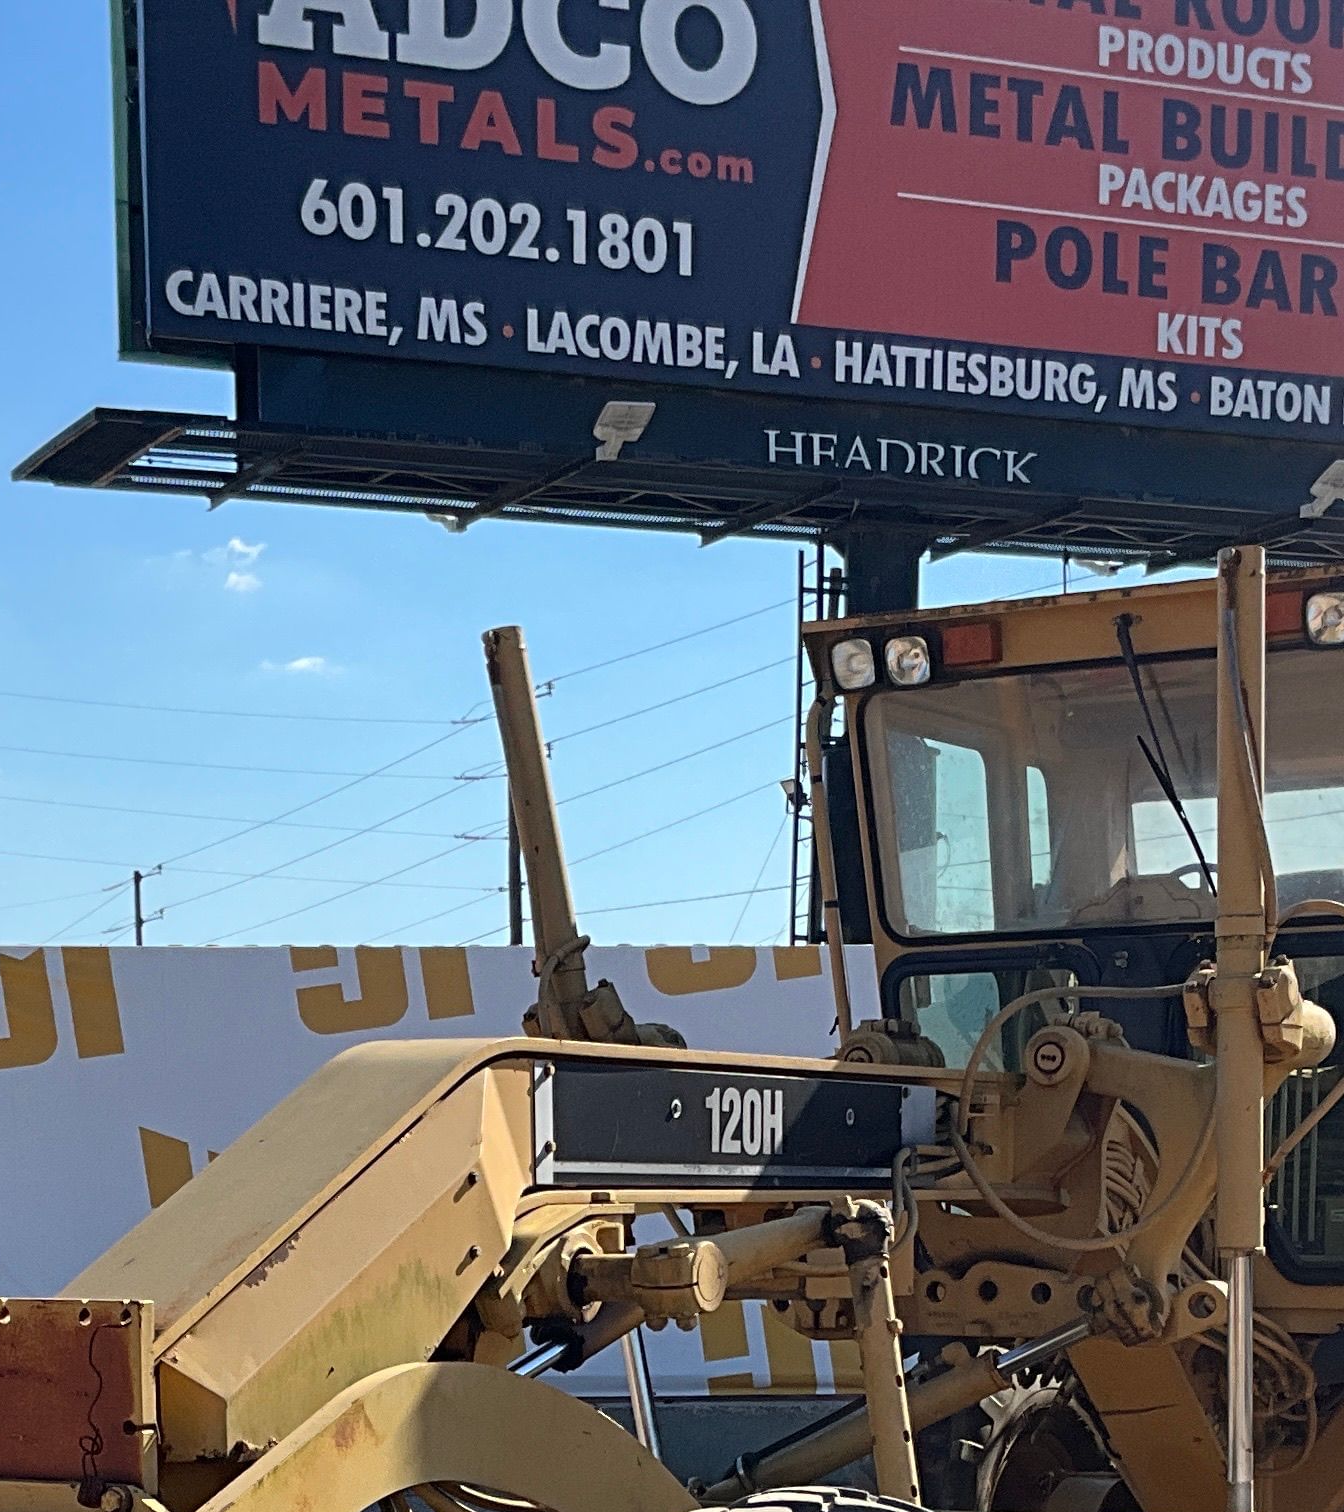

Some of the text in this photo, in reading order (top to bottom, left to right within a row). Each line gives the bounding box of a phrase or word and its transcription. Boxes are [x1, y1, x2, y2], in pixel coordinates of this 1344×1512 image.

[1098, 25, 1313, 94] PRODUCTS
[258, 60, 754, 184] METALS.com
[890, 63, 1129, 154] METAL
[302, 179, 691, 275] 601.202.1801
[1098, 164, 1308, 228] PACKAGES
[996, 220, 1168, 299] POLE
[166, 271, 402, 345] CARRIERE,
[418, 297, 486, 345] MS
[528, 309, 738, 378] LACOMBE,
[753, 332, 799, 377] LA
[836, 341, 1107, 412] HATTIESBURG,
[1119, 368, 1177, 411] MS
[1211, 377, 1330, 424] BATON
[1158, 312, 1243, 359] KITS
[765, 431, 1036, 482] HEADRICK
[706, 1088, 782, 1155] 120H
